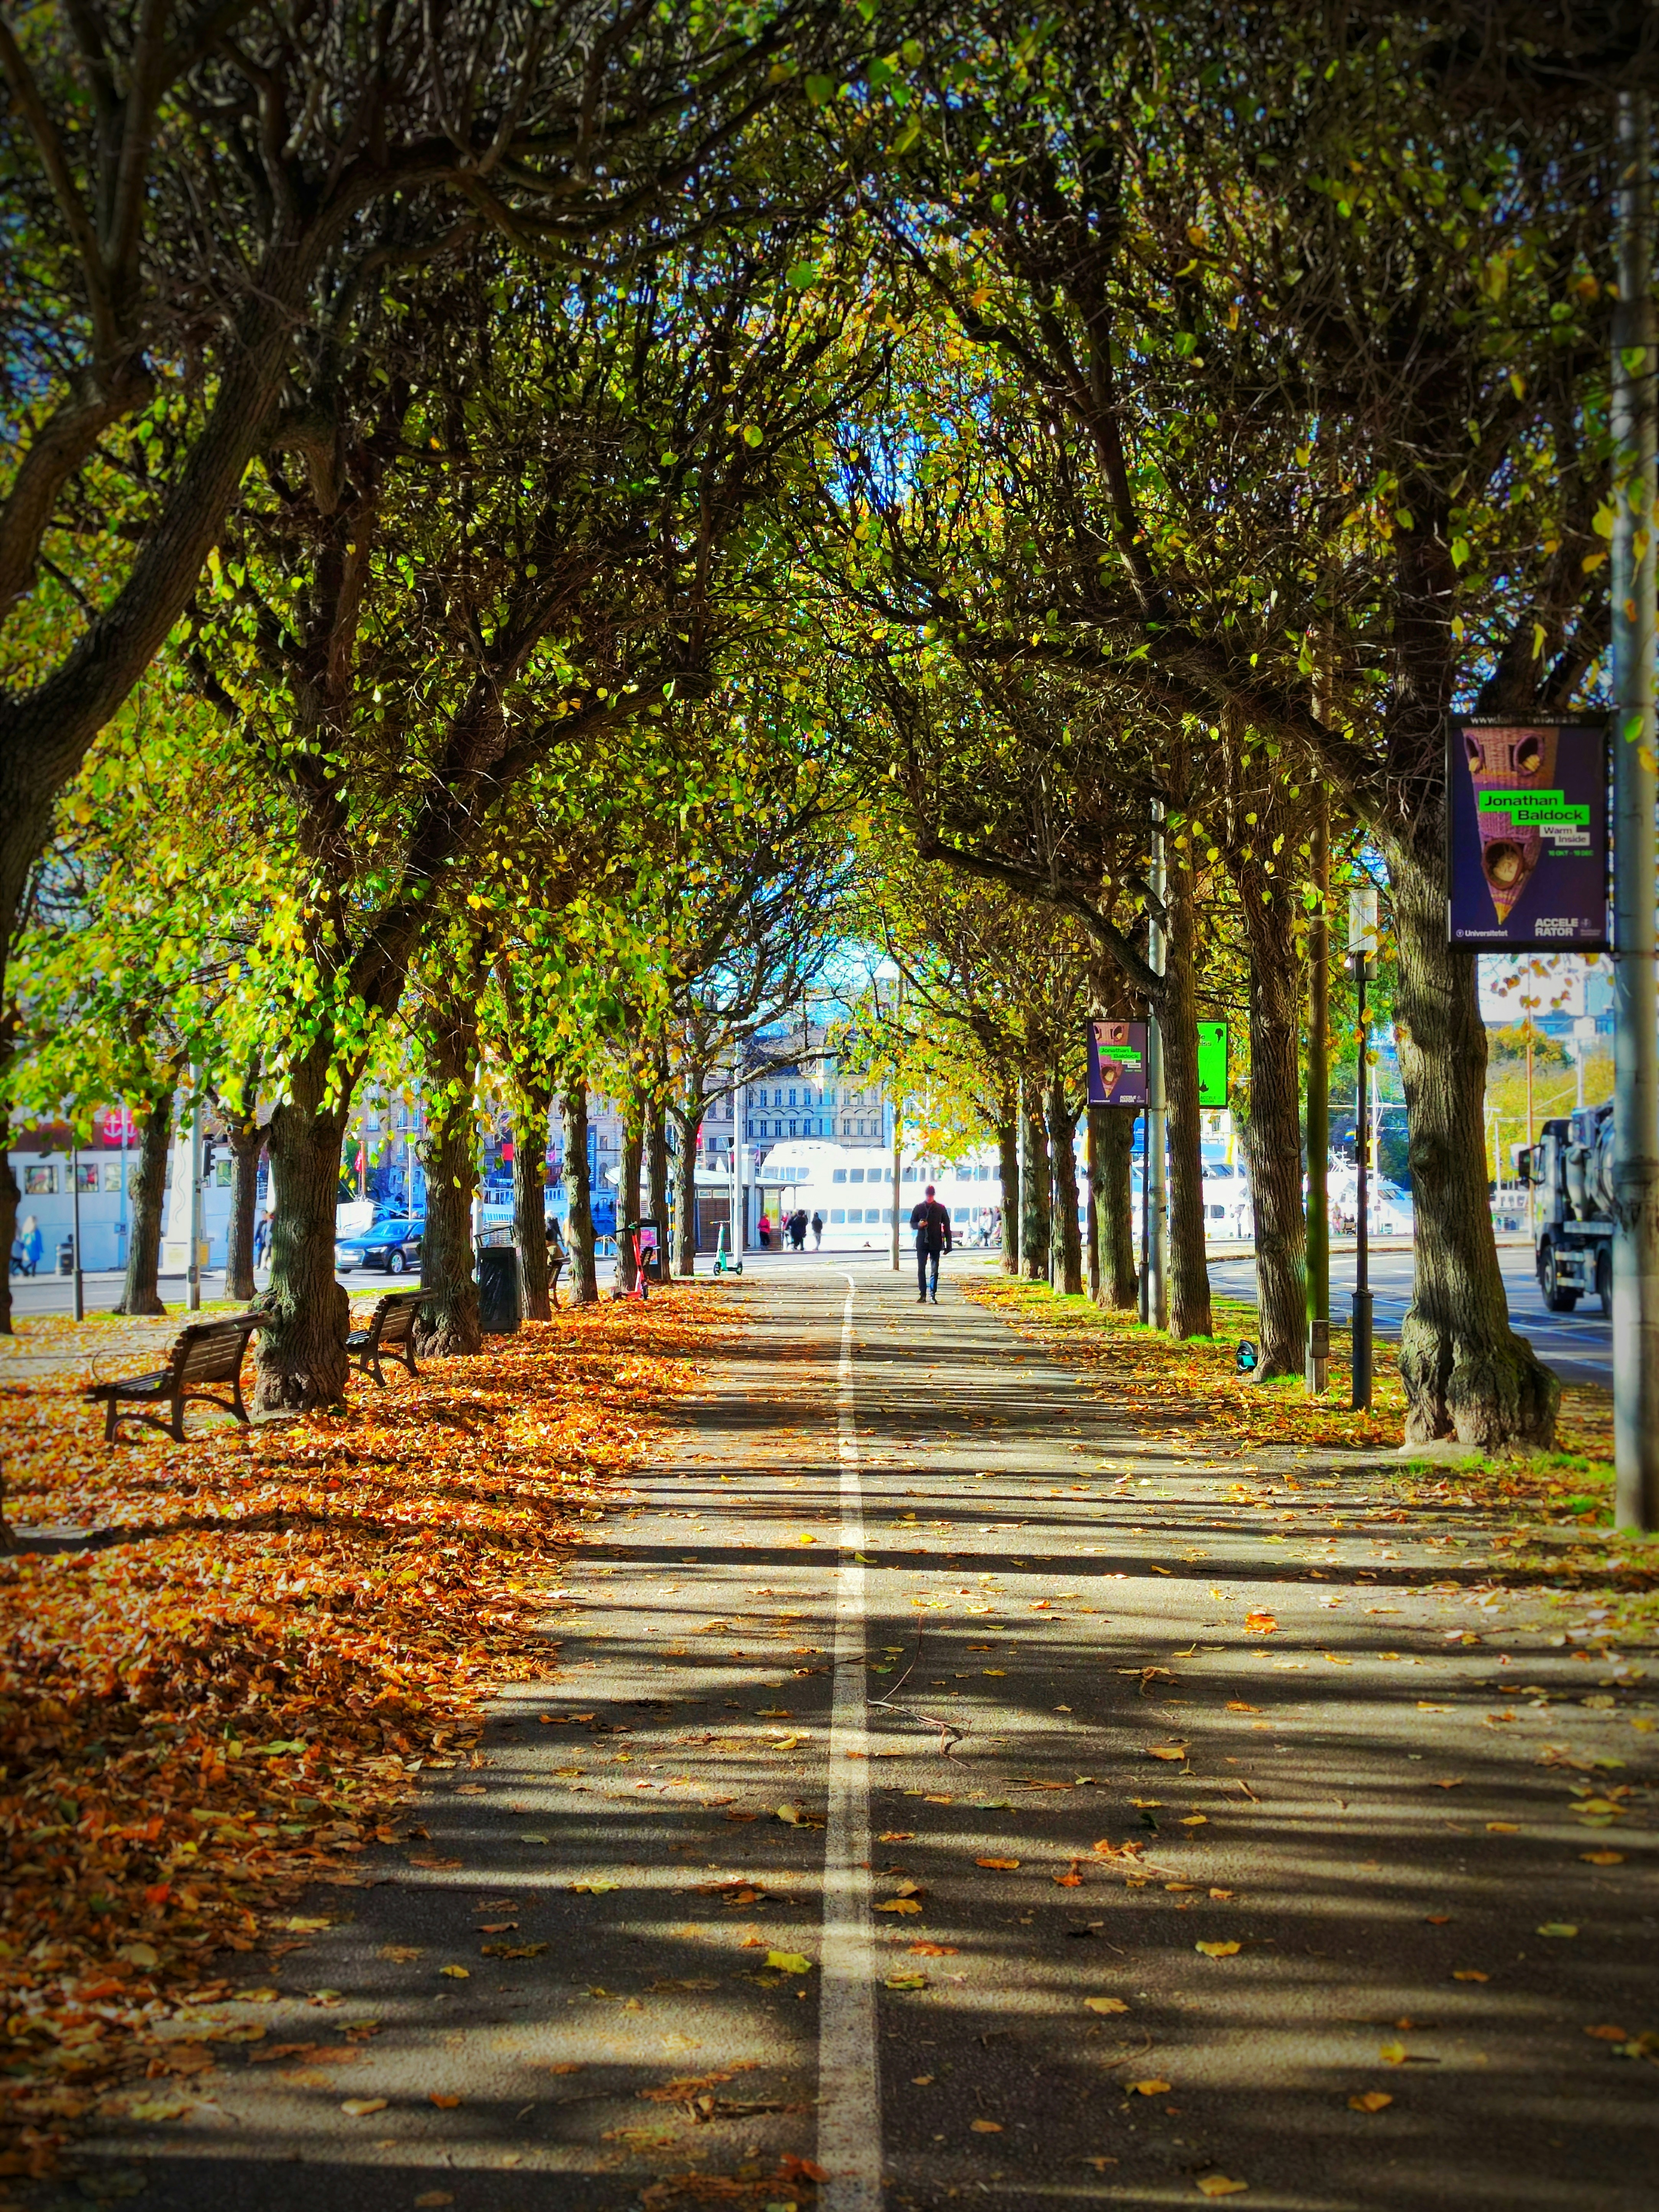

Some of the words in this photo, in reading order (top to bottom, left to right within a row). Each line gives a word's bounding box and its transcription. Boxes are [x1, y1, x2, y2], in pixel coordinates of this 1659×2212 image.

[1485, 795, 1557, 805] Jonathan
[1518, 810, 1583, 820] Baldock
[1534, 918, 1579, 927] ACCELE
[1535, 927, 1574, 936] RATOR
